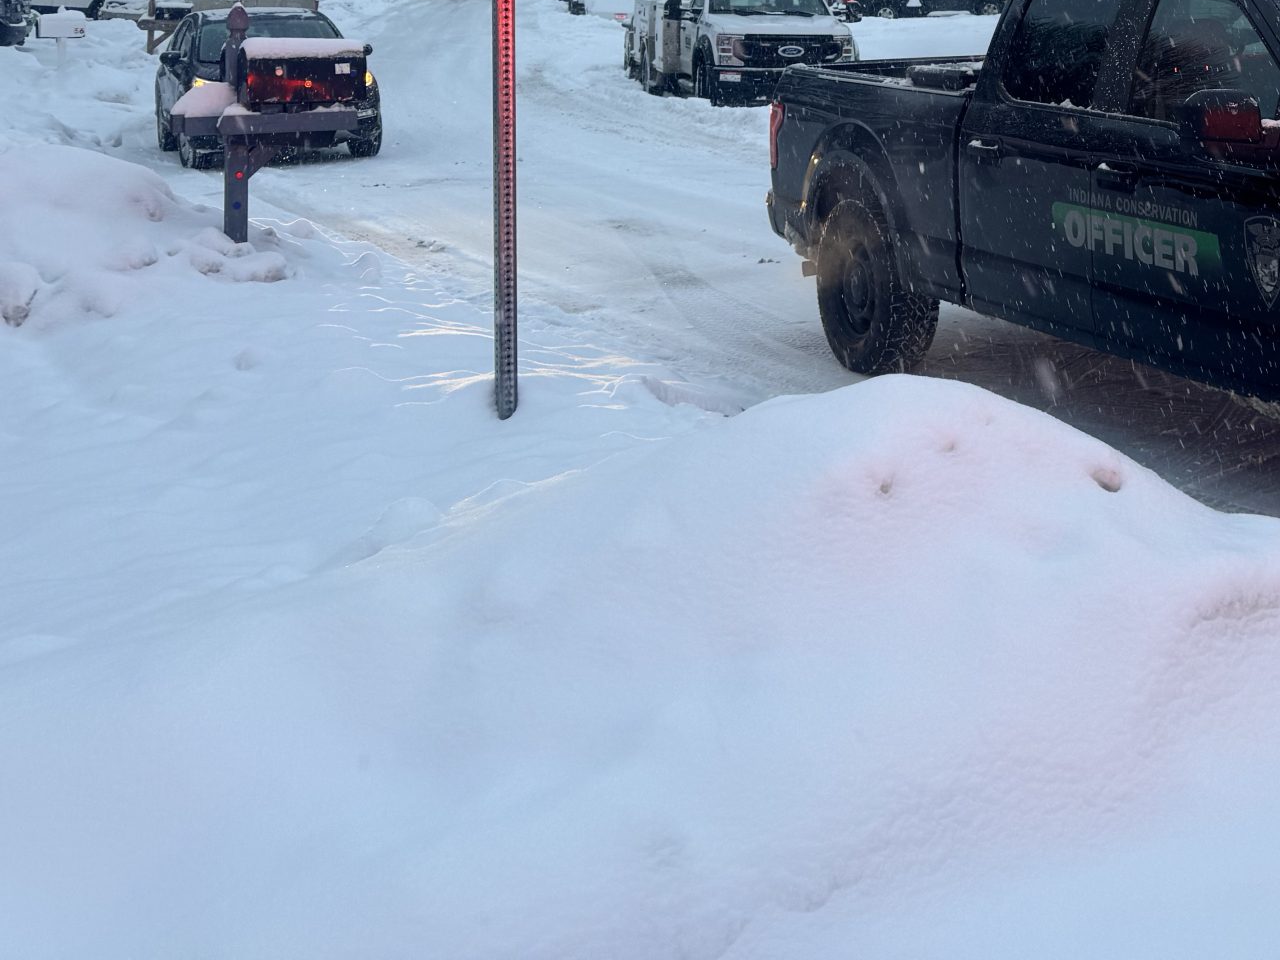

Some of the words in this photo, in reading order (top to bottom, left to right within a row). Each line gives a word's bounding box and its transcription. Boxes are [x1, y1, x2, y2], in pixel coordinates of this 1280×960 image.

[1069, 189, 1112, 210] INDIANA
[1115, 197, 1198, 227] CONSERVATION
[1064, 210, 1199, 277] OFFICER
